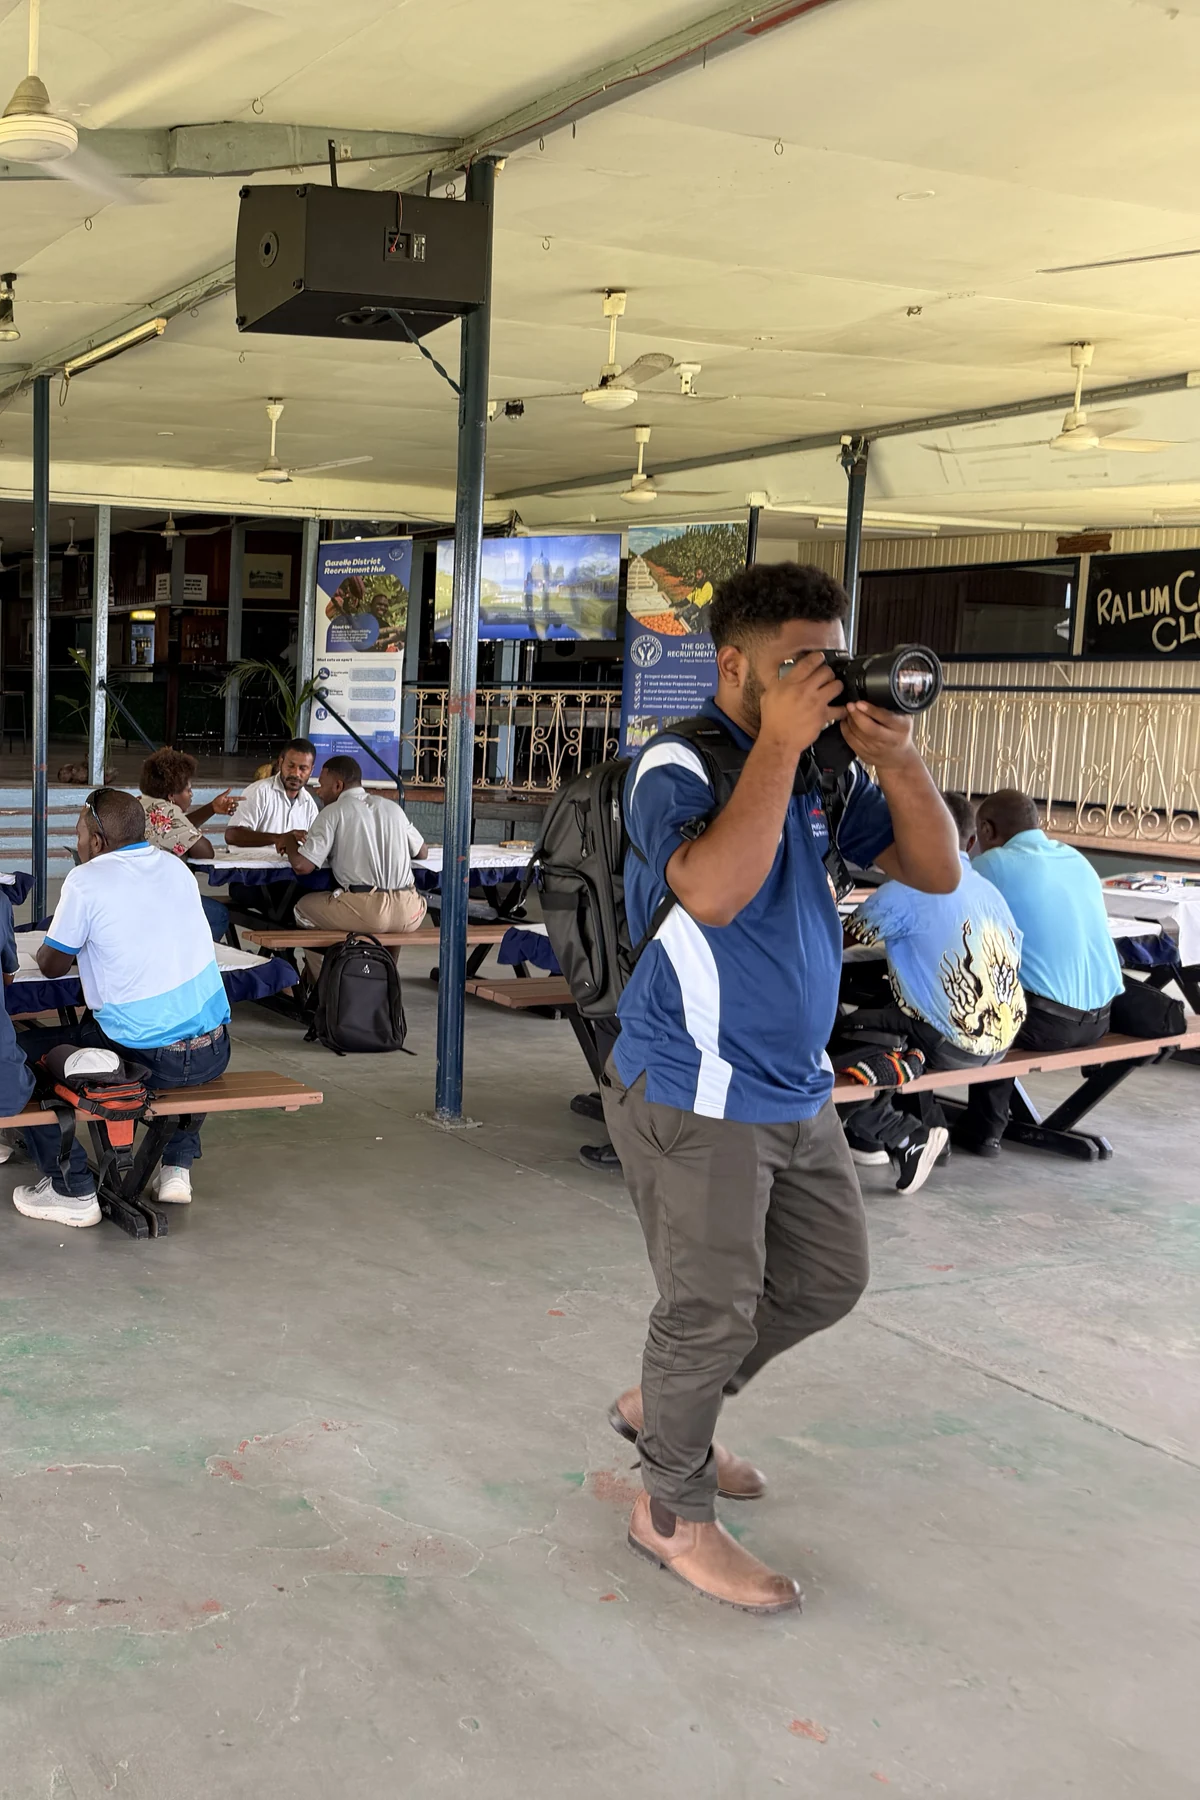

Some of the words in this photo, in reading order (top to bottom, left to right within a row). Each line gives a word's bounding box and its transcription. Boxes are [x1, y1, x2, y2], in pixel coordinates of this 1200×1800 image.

[325, 559, 352, 567] Gazelle
[352, 557, 381, 566] District
[324, 566, 370, 575] Recruitment
[371, 564, 386, 573] Hub
[1097, 585, 1170, 626] RALUM
[1174, 569, 1200, 613] C
